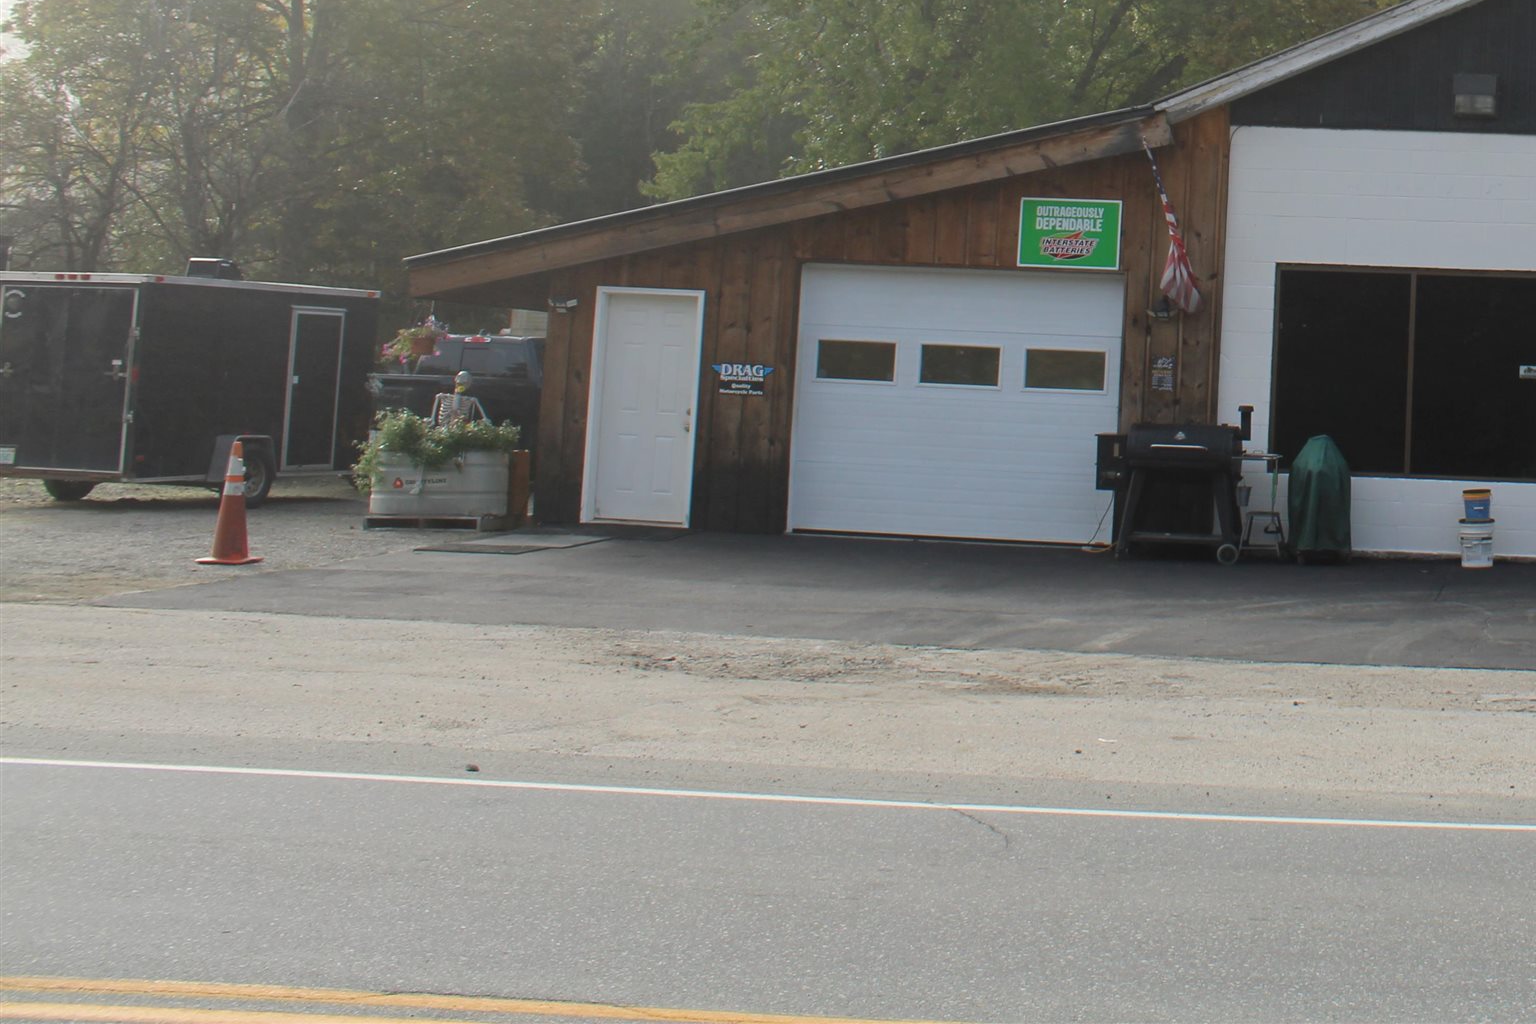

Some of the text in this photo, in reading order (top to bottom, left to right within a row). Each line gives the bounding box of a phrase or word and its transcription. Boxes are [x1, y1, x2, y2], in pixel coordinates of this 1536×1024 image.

[1036, 206, 1104, 218] OUTRAGEOUSLY
[1035, 217, 1103, 232] DEPENDABLE
[1042, 238, 1095, 247] INTERSTATE
[1043, 246, 1091, 254] BATTERIES
[721, 363, 764, 376] DRAG
